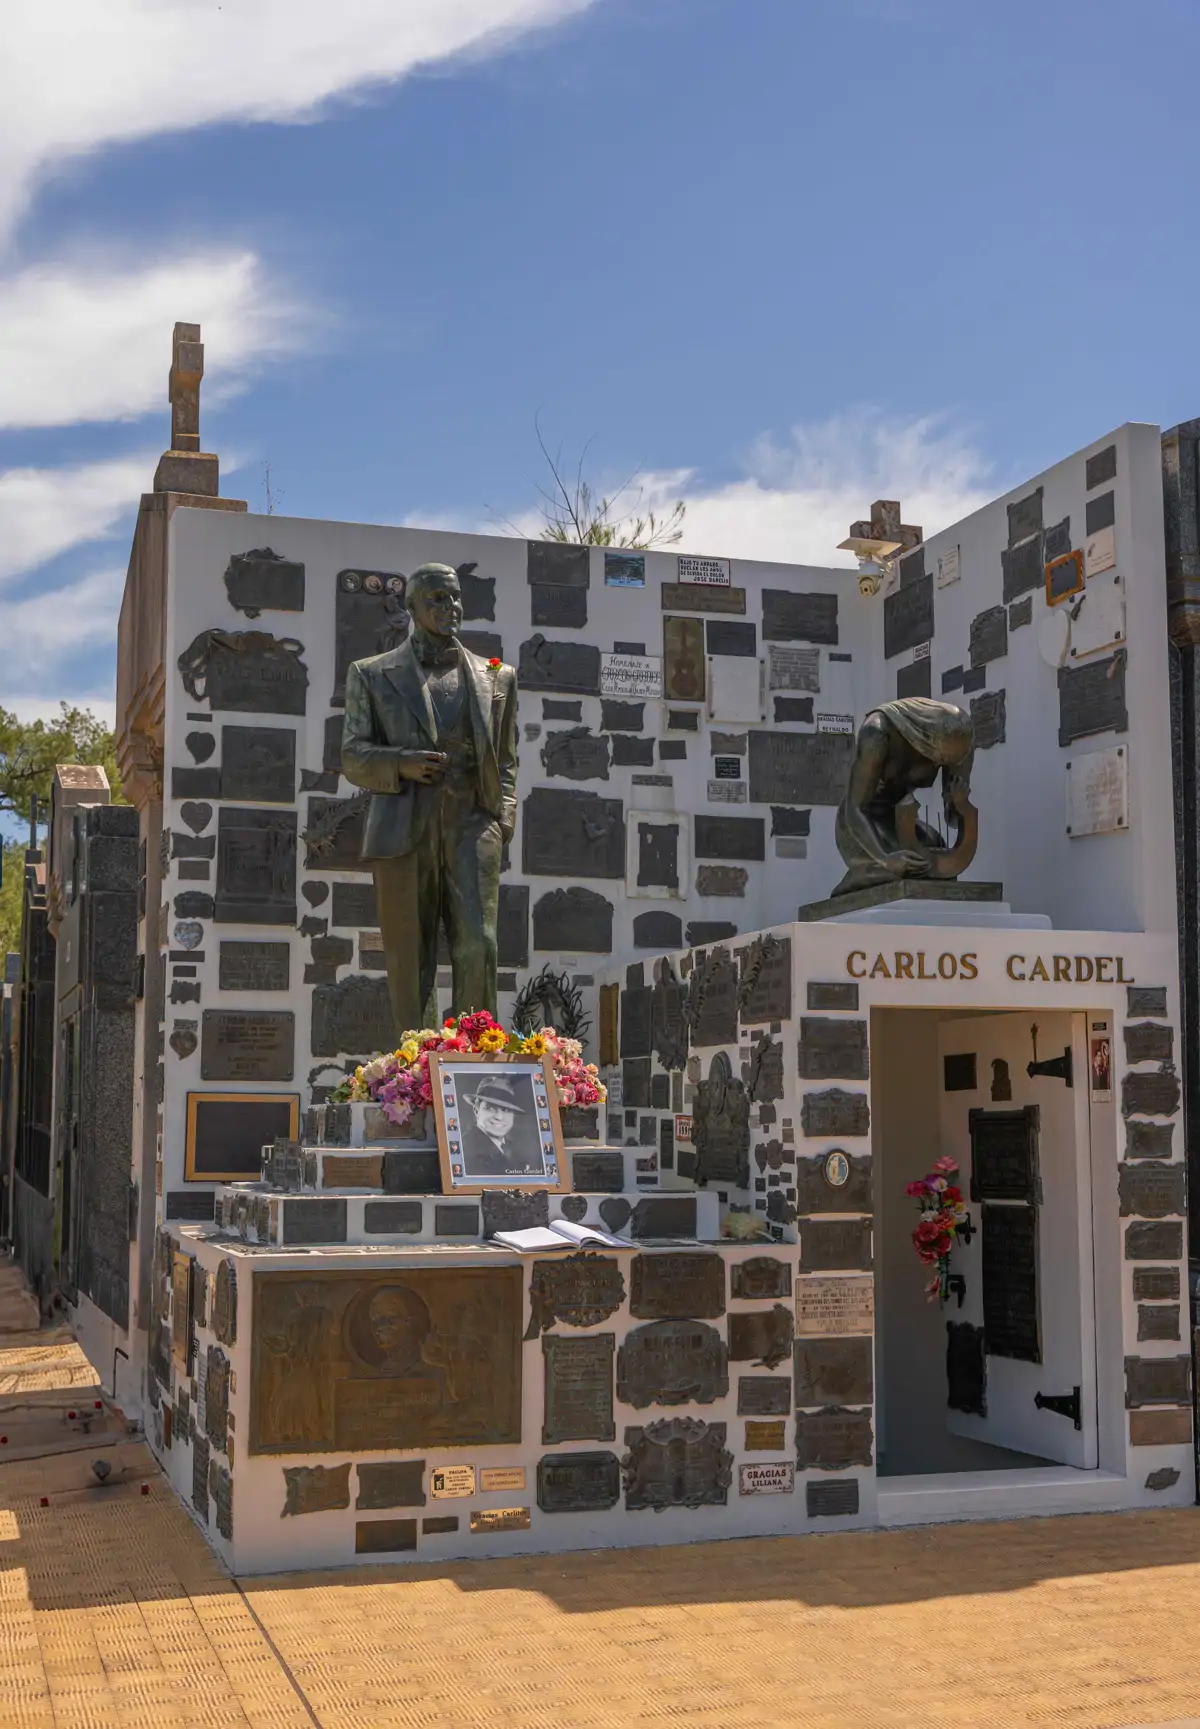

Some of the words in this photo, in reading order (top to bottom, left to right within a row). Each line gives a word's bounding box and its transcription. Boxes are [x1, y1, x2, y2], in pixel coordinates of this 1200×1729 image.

[846, 950, 979, 980] CARLOS
[1006, 955, 1135, 984] GARDEL
[747, 1469, 786, 1479] GRACIAS
[752, 1479, 782, 1487] LILIANA
